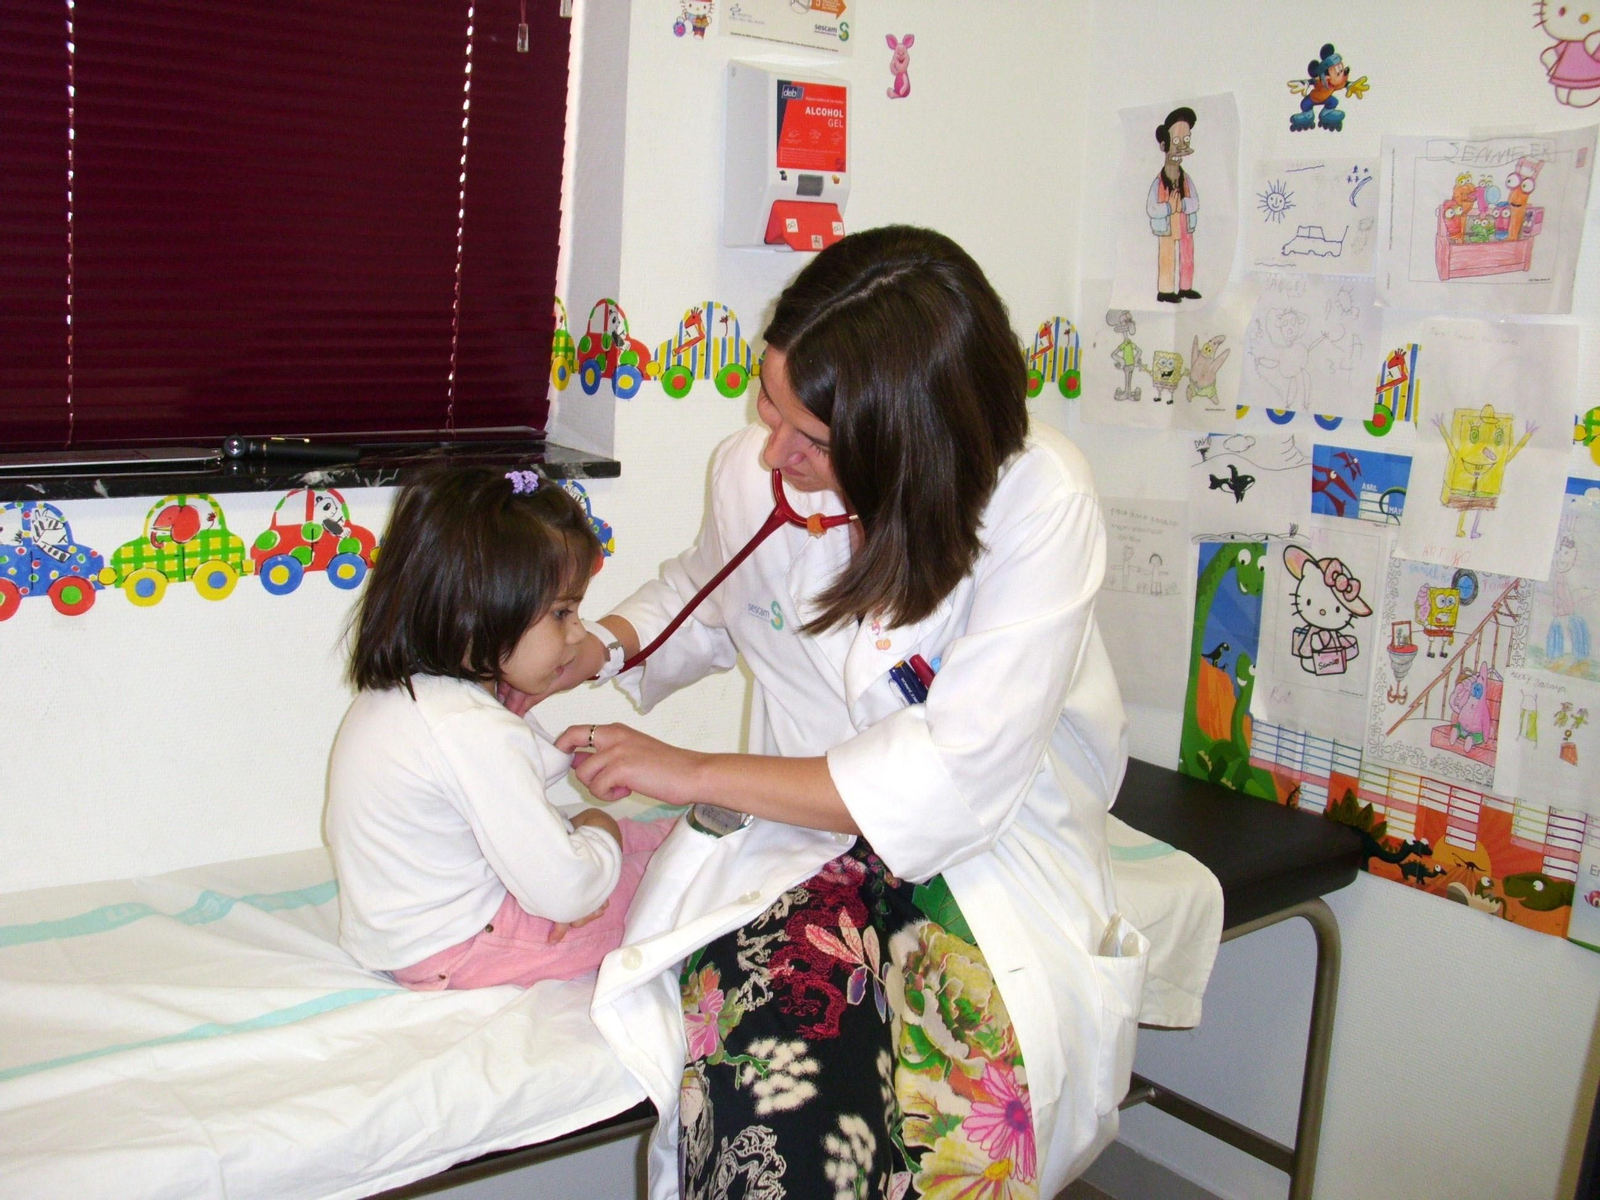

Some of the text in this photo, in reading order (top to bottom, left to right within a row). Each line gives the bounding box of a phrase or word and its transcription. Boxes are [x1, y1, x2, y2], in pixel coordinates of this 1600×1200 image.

[814, 23, 838, 33] sescam
[783, 88, 797, 98] deb
[805, 106, 844, 118] ALCOHOL
[827, 118, 844, 129] GEL
[1361, 482, 1378, 492] ABRIL
[748, 603, 770, 619] sescam
